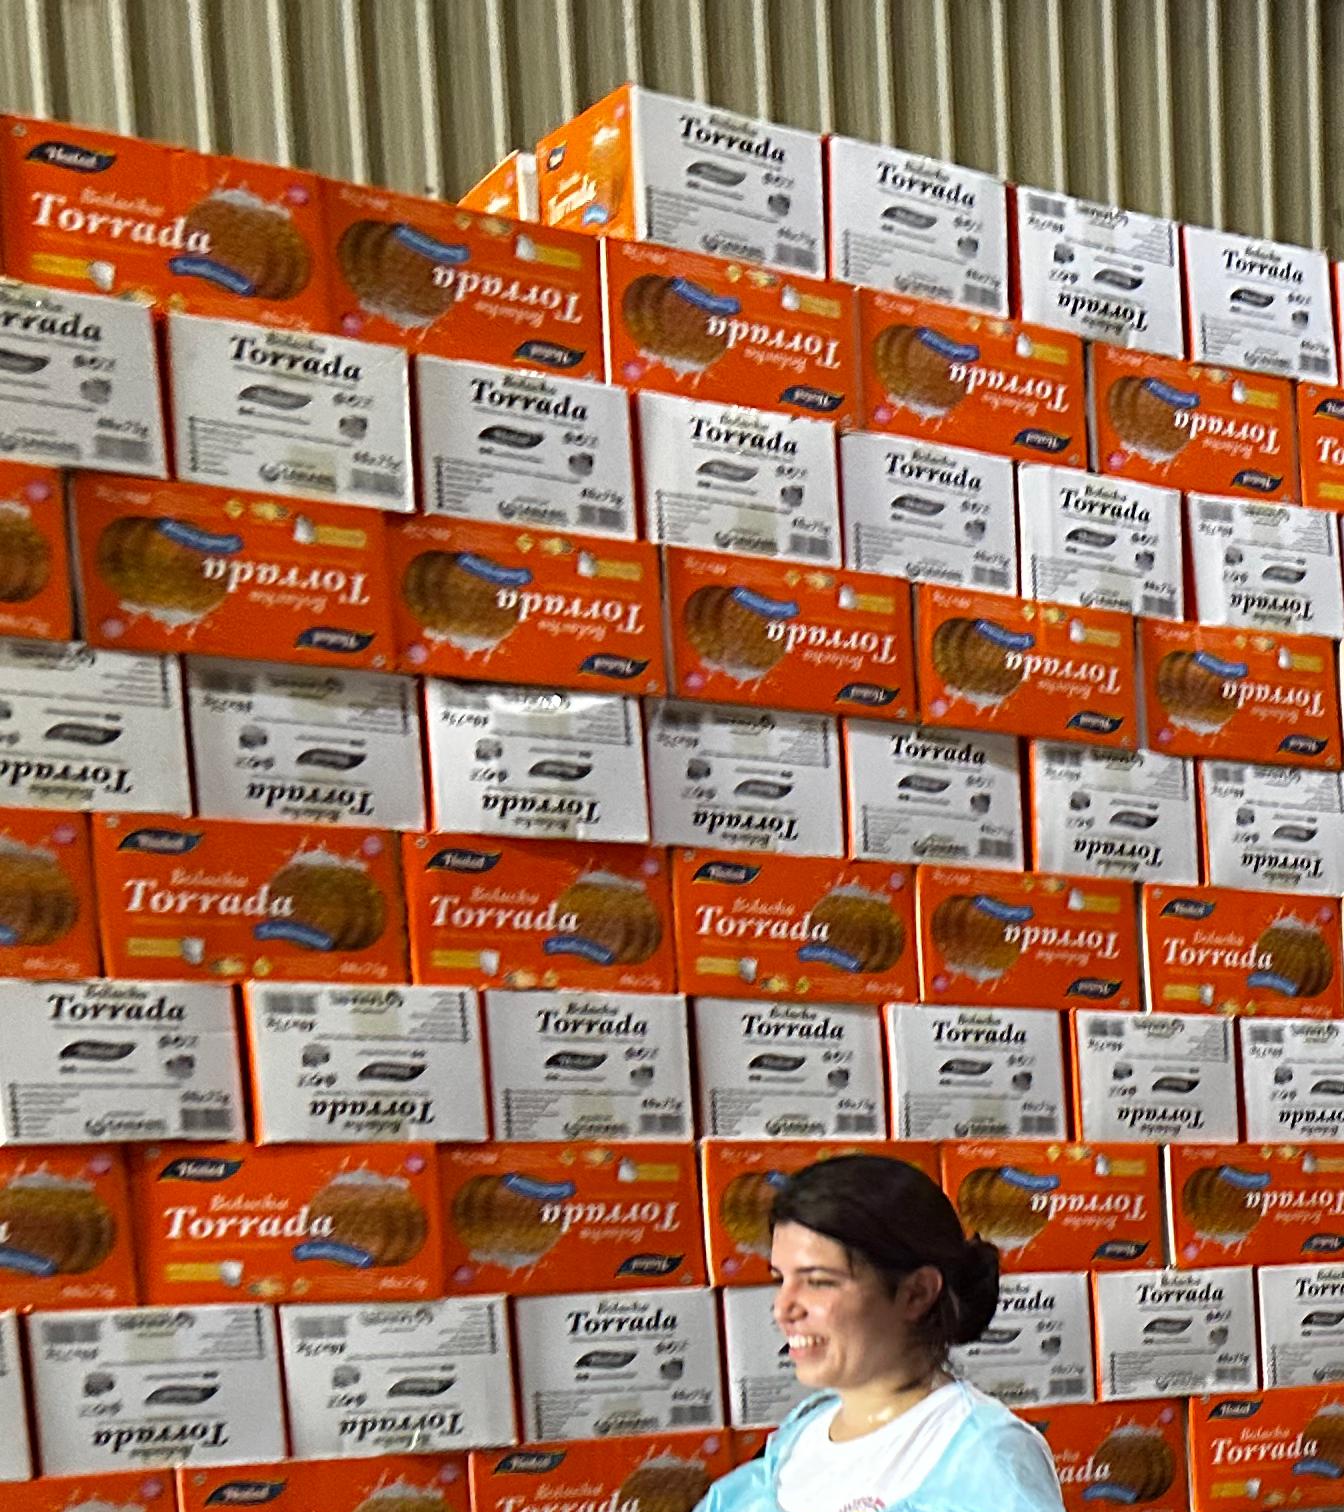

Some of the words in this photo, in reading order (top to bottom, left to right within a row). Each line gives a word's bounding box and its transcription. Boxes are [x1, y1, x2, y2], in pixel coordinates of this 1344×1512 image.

[680, 115, 786, 163] Torrada
[877, 161, 976, 209] Torrada
[31, 191, 213, 255] Torrada
[1222, 249, 1304, 283] Torrada
[432, 264, 584, 325] Torrada
[1057, 291, 1149, 333] Torrada
[0, 309, 102, 344] rrada
[706, 315, 842, 369] Torrada
[229, 334, 363, 383] Torrada
[470, 376, 589, 423] Torrada
[948, 361, 1070, 414] Torrada
[690, 416, 799, 456] Torrada
[1173, 409, 1280, 455] Torrada
[885, 451, 982, 493] Torrada
[1059, 487, 1150, 524] Torrada
[203, 556, 369, 605] Torrada
[497, 587, 645, 635] Torrada
[1231, 594, 1315, 621] Torrada
[765, 619, 898, 665] Torrada
[1004, 651, 1122, 695] Torrada
[1222, 681, 1325, 716] Torrada
[891, 736, 985, 765] Torrada
[0, 754, 134, 794] Torrad
[246, 781, 375, 817] Torrada
[482, 792, 601, 826] Torrada
[692, 810, 800, 840] Torrada
[1072, 837, 1164, 868] Torrada
[1241, 853, 1324, 879] Torrada
[122, 877, 297, 918] Torrada
[430, 894, 581, 935] Torrada
[696, 905, 830, 941] Torrada
[1004, 922, 1121, 960] Torrada
[1163, 937, 1273, 970] Torrada
[46, 993, 188, 1023] Torrada
[536, 1007, 648, 1037] Torrada
[741, 1015, 844, 1041] Torrada
[932, 1021, 1028, 1045] Torrada
[310, 1099, 438, 1126] Torrada
[1117, 1106, 1205, 1130] Torrada
[163, 1205, 335, 1241] Torrada
[540, 1201, 681, 1233] Torrada
[1031, 1191, 1145, 1222] Torrada
[1136, 1284, 1225, 1304] Torrada
[566, 1309, 678, 1334] Torrada
[92, 1418, 231, 1454] Torrada
[338, 1411, 466, 1445] Torrada
[1210, 1432, 1318, 1465] Torrada
